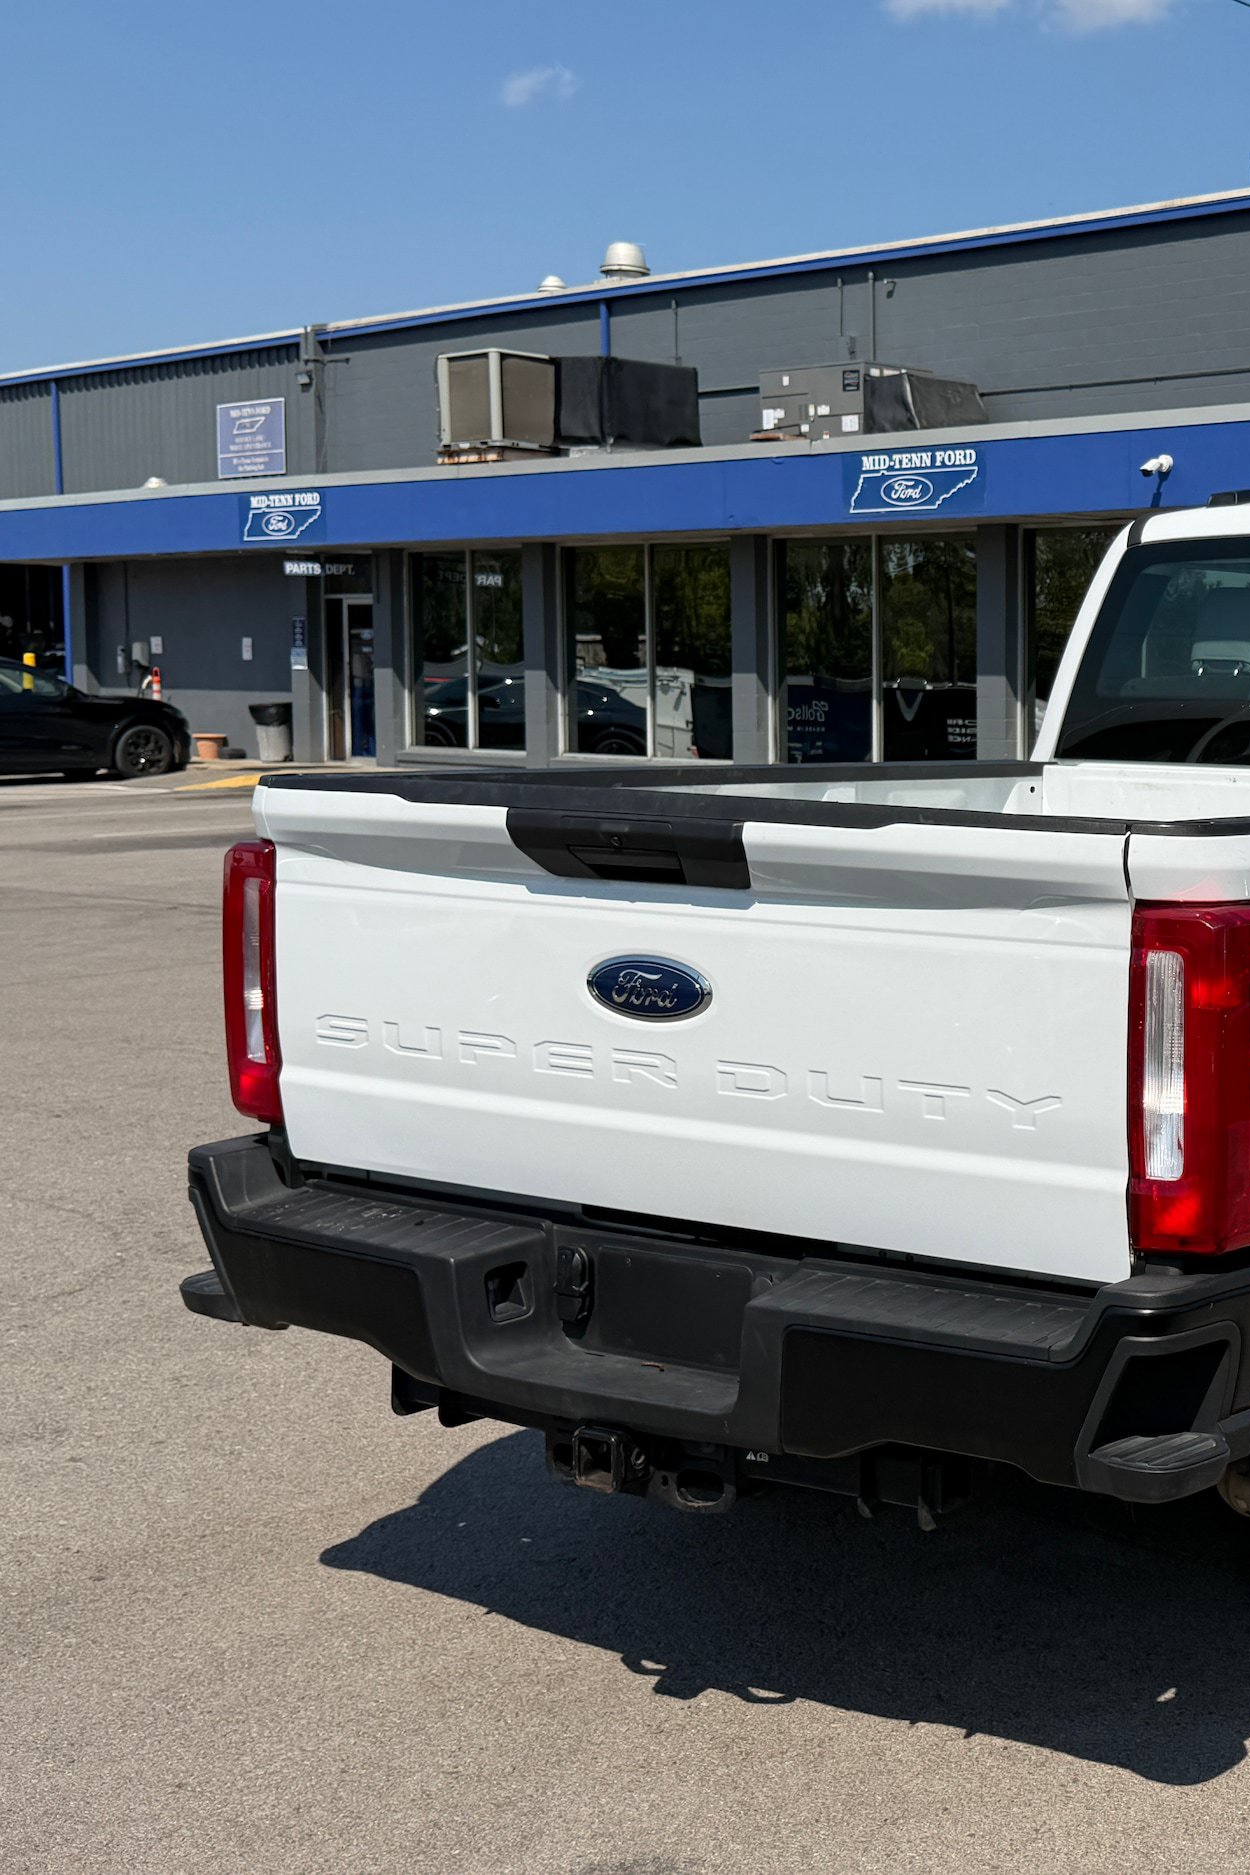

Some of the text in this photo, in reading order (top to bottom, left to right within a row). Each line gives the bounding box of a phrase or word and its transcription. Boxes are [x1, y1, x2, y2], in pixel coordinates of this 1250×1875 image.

[862, 449, 976, 471] MID-TENN FORD
[891, 480, 922, 499] Ford
[250, 492, 320, 508] MID-TENN FORD
[284, 561, 355, 575] PARTS DEPT.
[611, 969, 679, 1008] Ford
[315, 1013, 1063, 1130] SUPER DUTY
